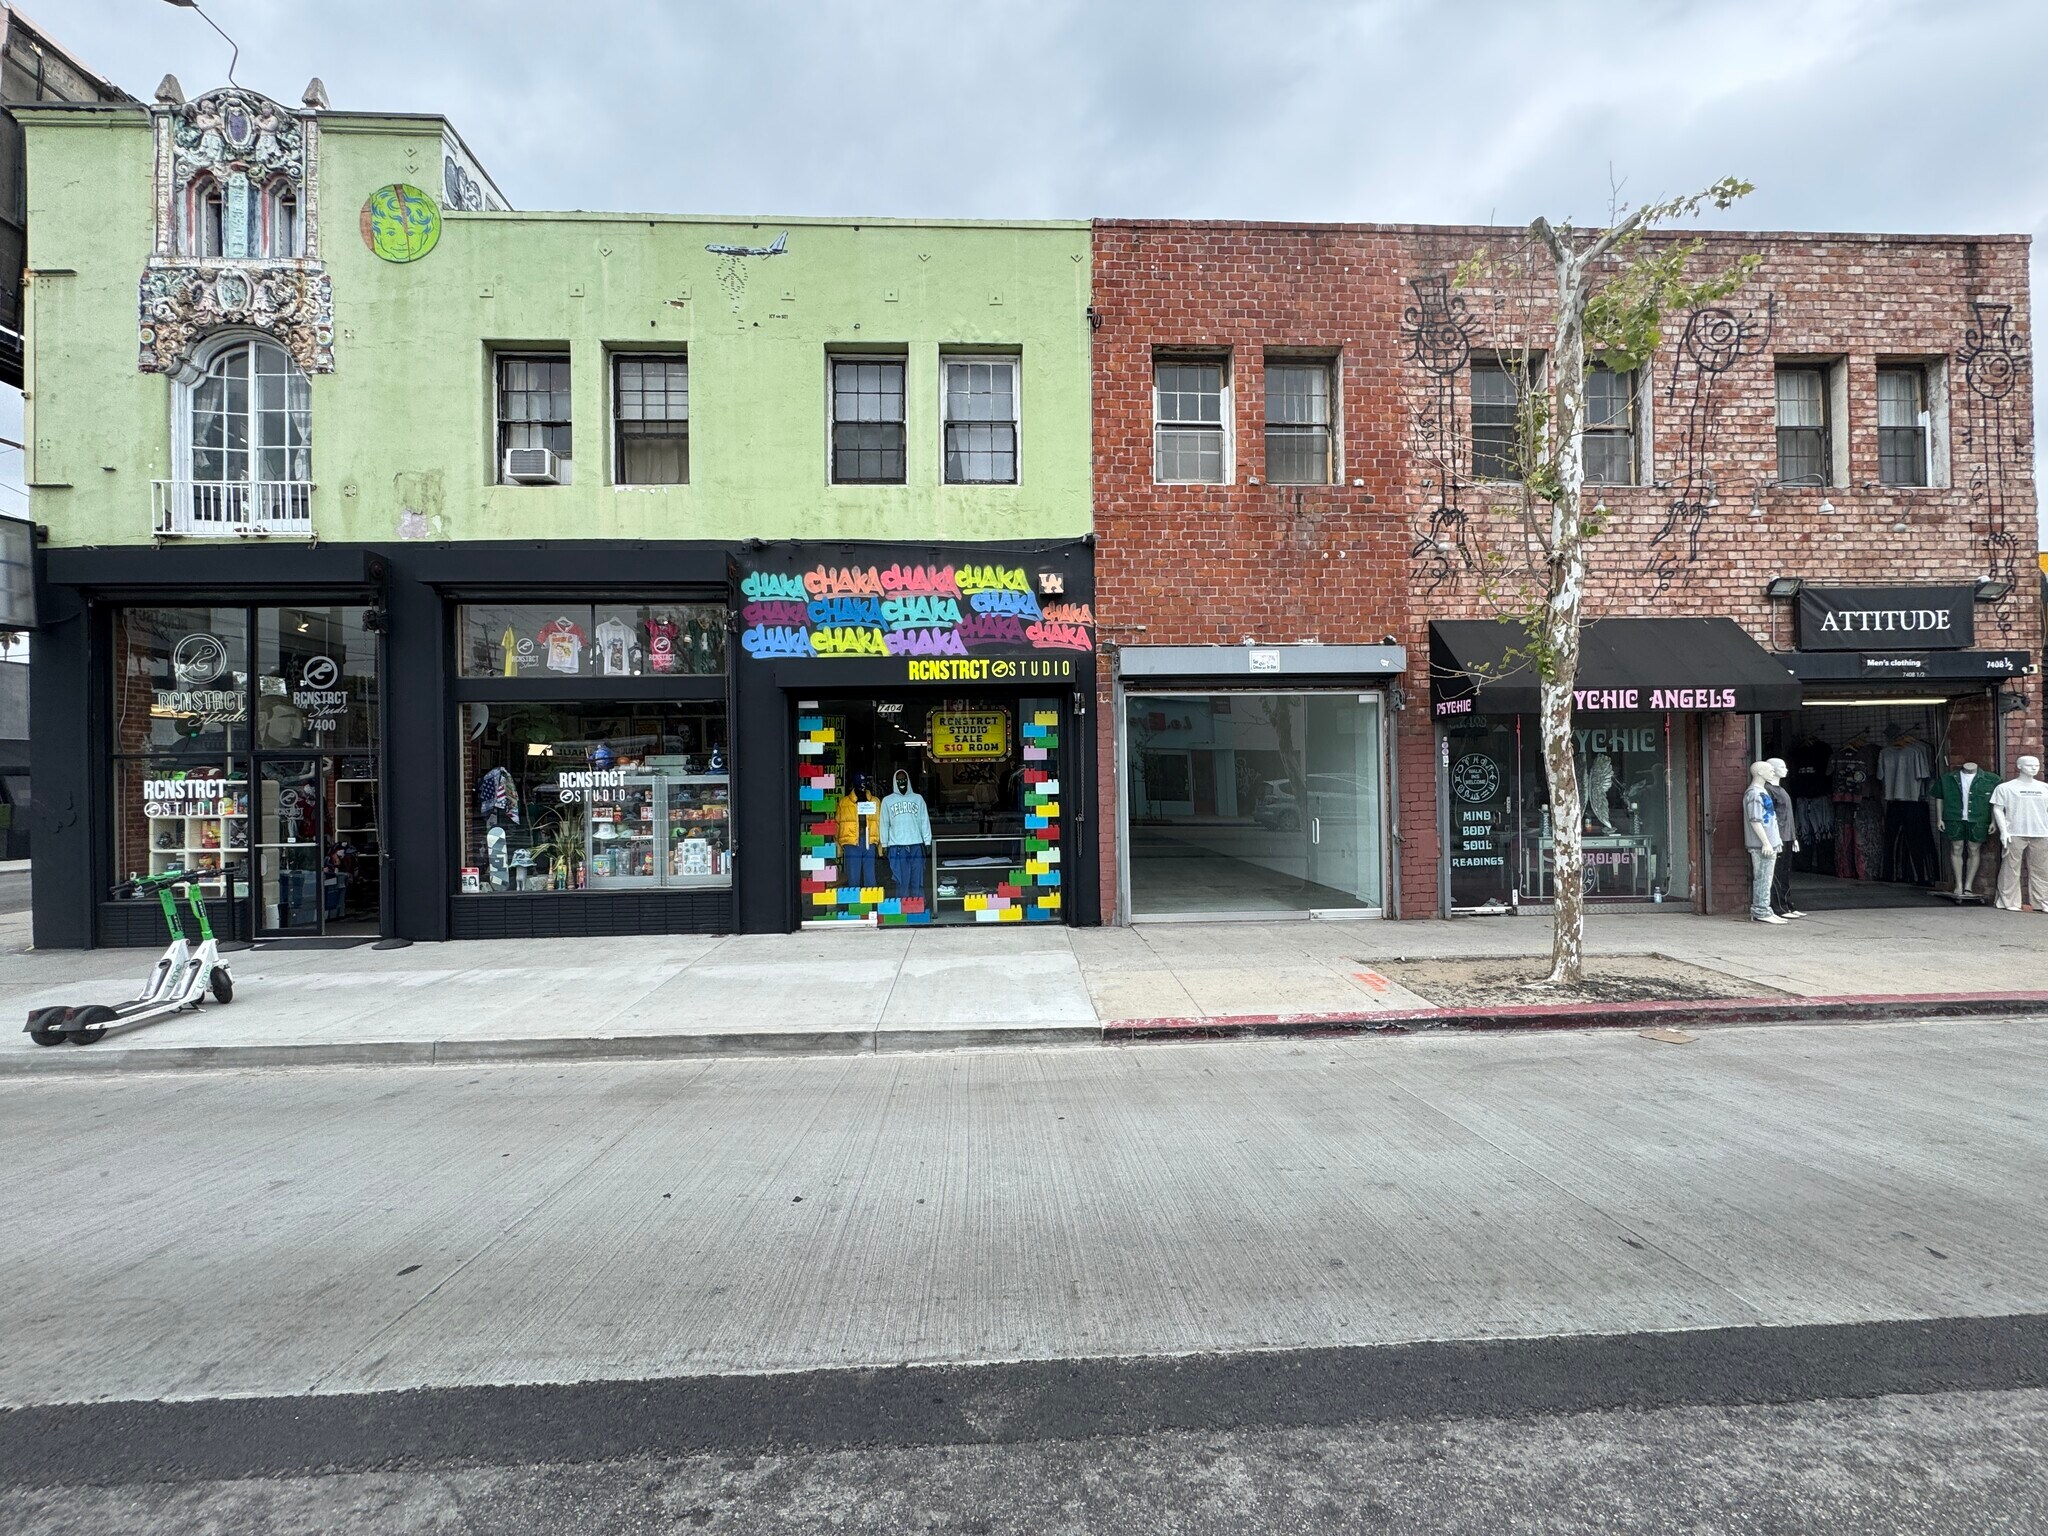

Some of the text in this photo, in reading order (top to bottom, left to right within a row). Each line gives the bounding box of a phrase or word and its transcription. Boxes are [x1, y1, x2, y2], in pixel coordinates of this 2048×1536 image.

[741, 563, 1033, 602] CHAKA CHAKA CHAKA CHAKA
[742, 590, 1043, 632] CHAKA CHAKA CHAKA CHAKA
[1043, 601, 1095, 628] CHAKA
[1820, 609, 1951, 632] ATTITUDE
[742, 612, 1092, 658] CHAKA CHAKA CHAKA CHAKA CHAKA
[908, 660, 1071, 681] RCNSTRCT STUDIO
[1866, 659, 1921, 668] Men's clothing
[158, 690, 247, 712] RCNSTRCT
[293, 691, 349, 705] RCNSTRCT
[1573, 688, 1736, 710] YCHIC ANGELS
[187, 702, 248, 727] Studio
[307, 701, 349, 718] Studio
[879, 704, 902, 713] 7404
[1436, 699, 1472, 716] PSYCHIC
[307, 718, 337, 731] 7400
[939, 717, 999, 726] RCNSTRCT
[948, 726, 988, 735] STUDIO
[954, 735, 983, 743] SALE
[968, 743, 999, 752] ROOM
[1574, 728, 1656, 752] YCHIC
[559, 770, 627, 788] RCNSTRCT
[143, 779, 227, 799] RCNSTRCT
[574, 789, 626, 802] STUDIO
[162, 801, 226, 817] STUDIO
[1463, 811, 1492, 821] MIND
[1462, 825, 1492, 836] BODY
[1463, 840, 1493, 851] SOUL
[1452, 857, 1505, 868] READINGS
[167, 963, 212, 990] Lime Lime
